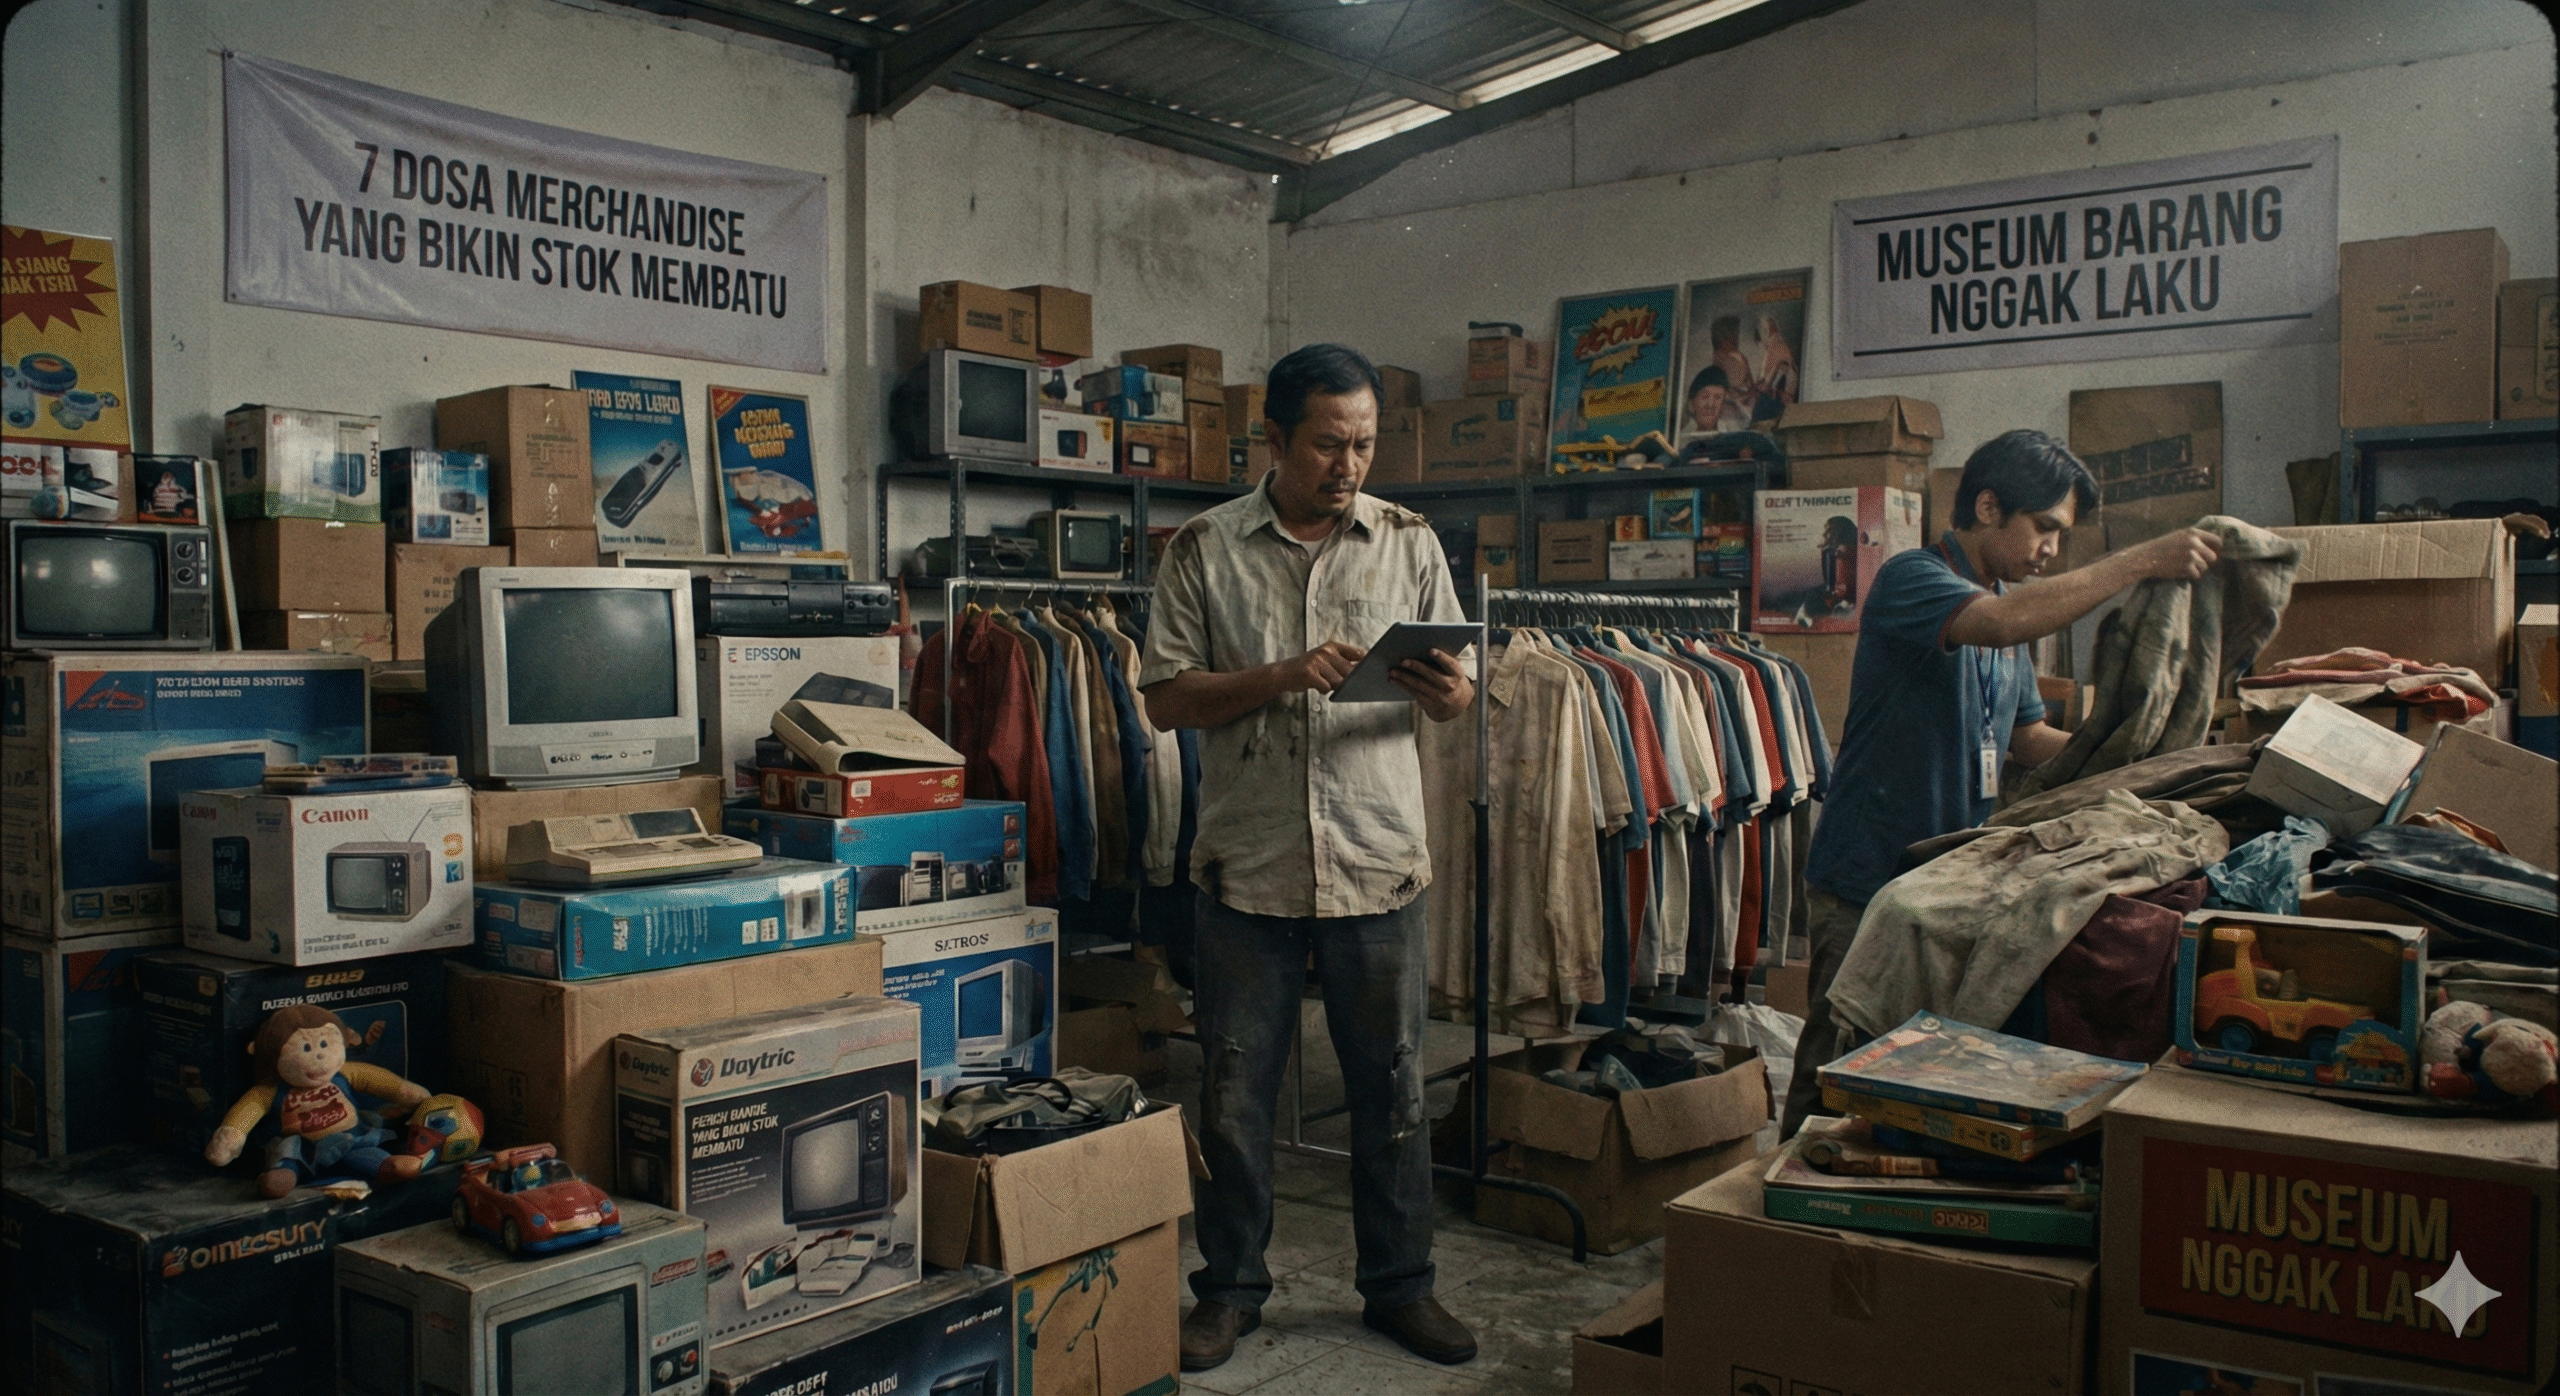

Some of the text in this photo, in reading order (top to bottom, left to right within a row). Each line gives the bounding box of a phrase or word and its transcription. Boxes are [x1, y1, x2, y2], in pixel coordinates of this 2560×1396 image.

[354, 140, 746, 257] 7 DOSA MERCHANDISE
[1877, 185, 2282, 282] MUSEUM BARANG
[15, 256, 71, 274] SIANG
[294, 196, 787, 319] YANG BIKIN STOK MEMBATU
[1930, 254, 2220, 334] NGGAK LAKU
[745, 647, 801, 661] EPSSON
[301, 808, 369, 824] Canon
[2205, 1166, 2451, 1264] MUSEUM
[2181, 1236, 2342, 1316] NGGAK
